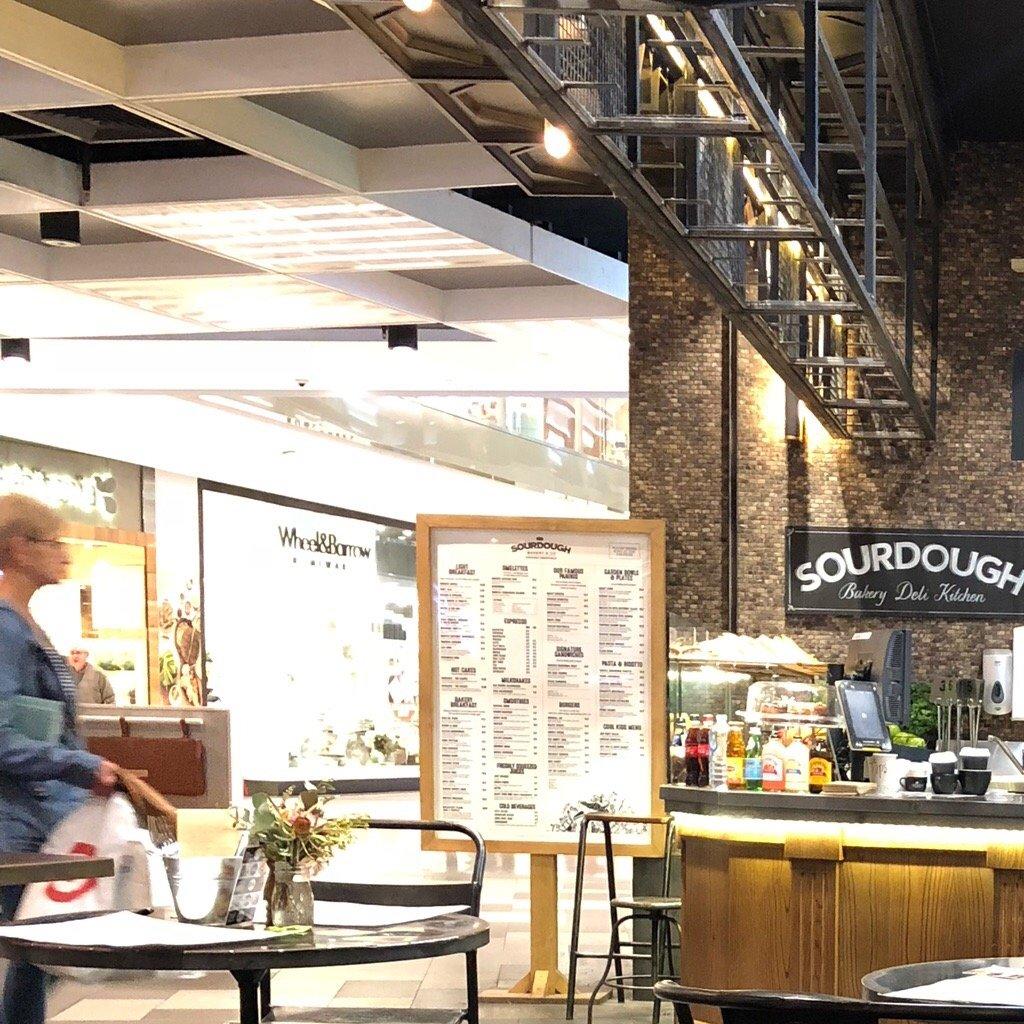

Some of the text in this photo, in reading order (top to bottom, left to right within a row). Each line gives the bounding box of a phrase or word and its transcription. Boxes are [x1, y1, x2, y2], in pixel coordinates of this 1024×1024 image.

[511, 541, 571, 554] SOURDOUGH
[839, 580, 986, 607] Bakery Deli Kitchen
